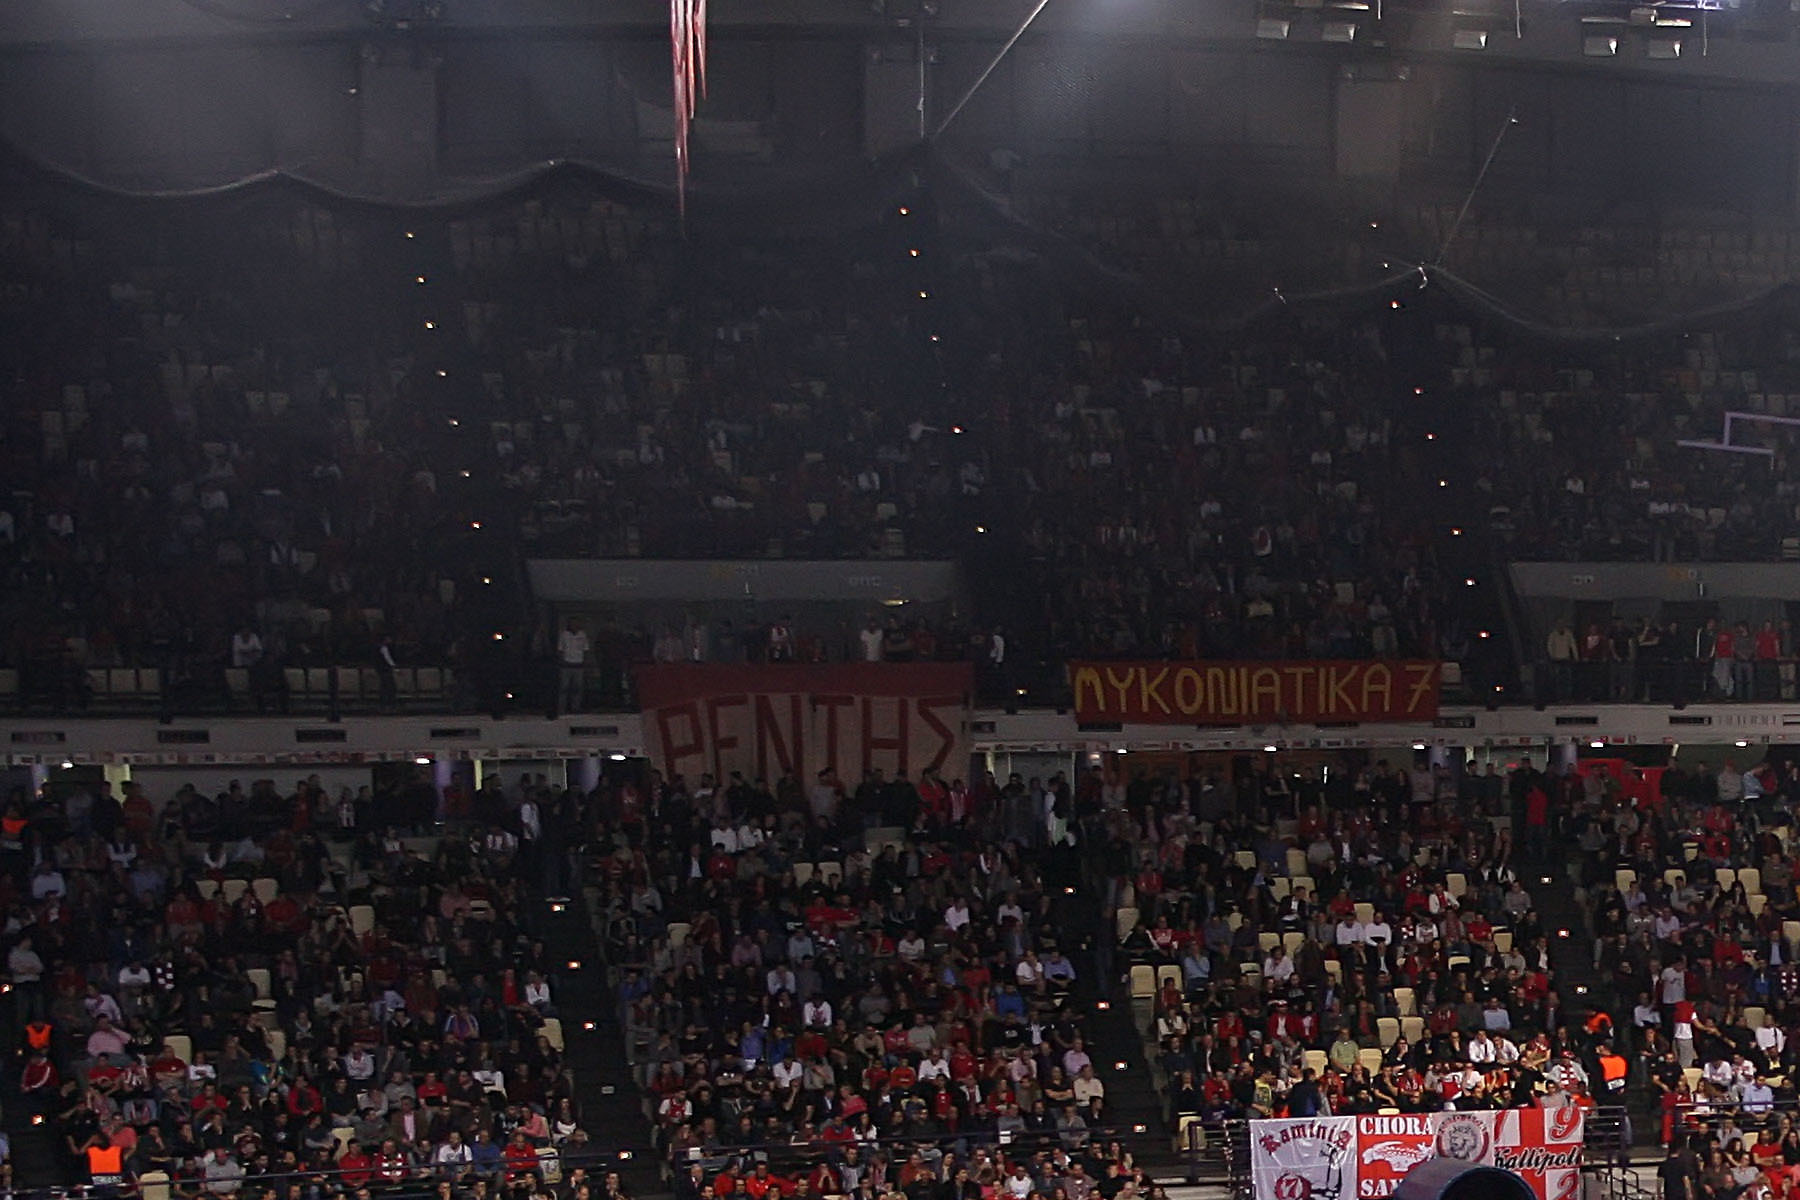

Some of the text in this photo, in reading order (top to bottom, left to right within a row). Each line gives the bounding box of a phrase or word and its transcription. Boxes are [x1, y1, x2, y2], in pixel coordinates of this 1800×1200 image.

[1074, 663, 1437, 717] MYKONIATIKA 7
[1360, 1117, 1433, 1135] CHORA
[1550, 1106, 1582, 1140] 9
